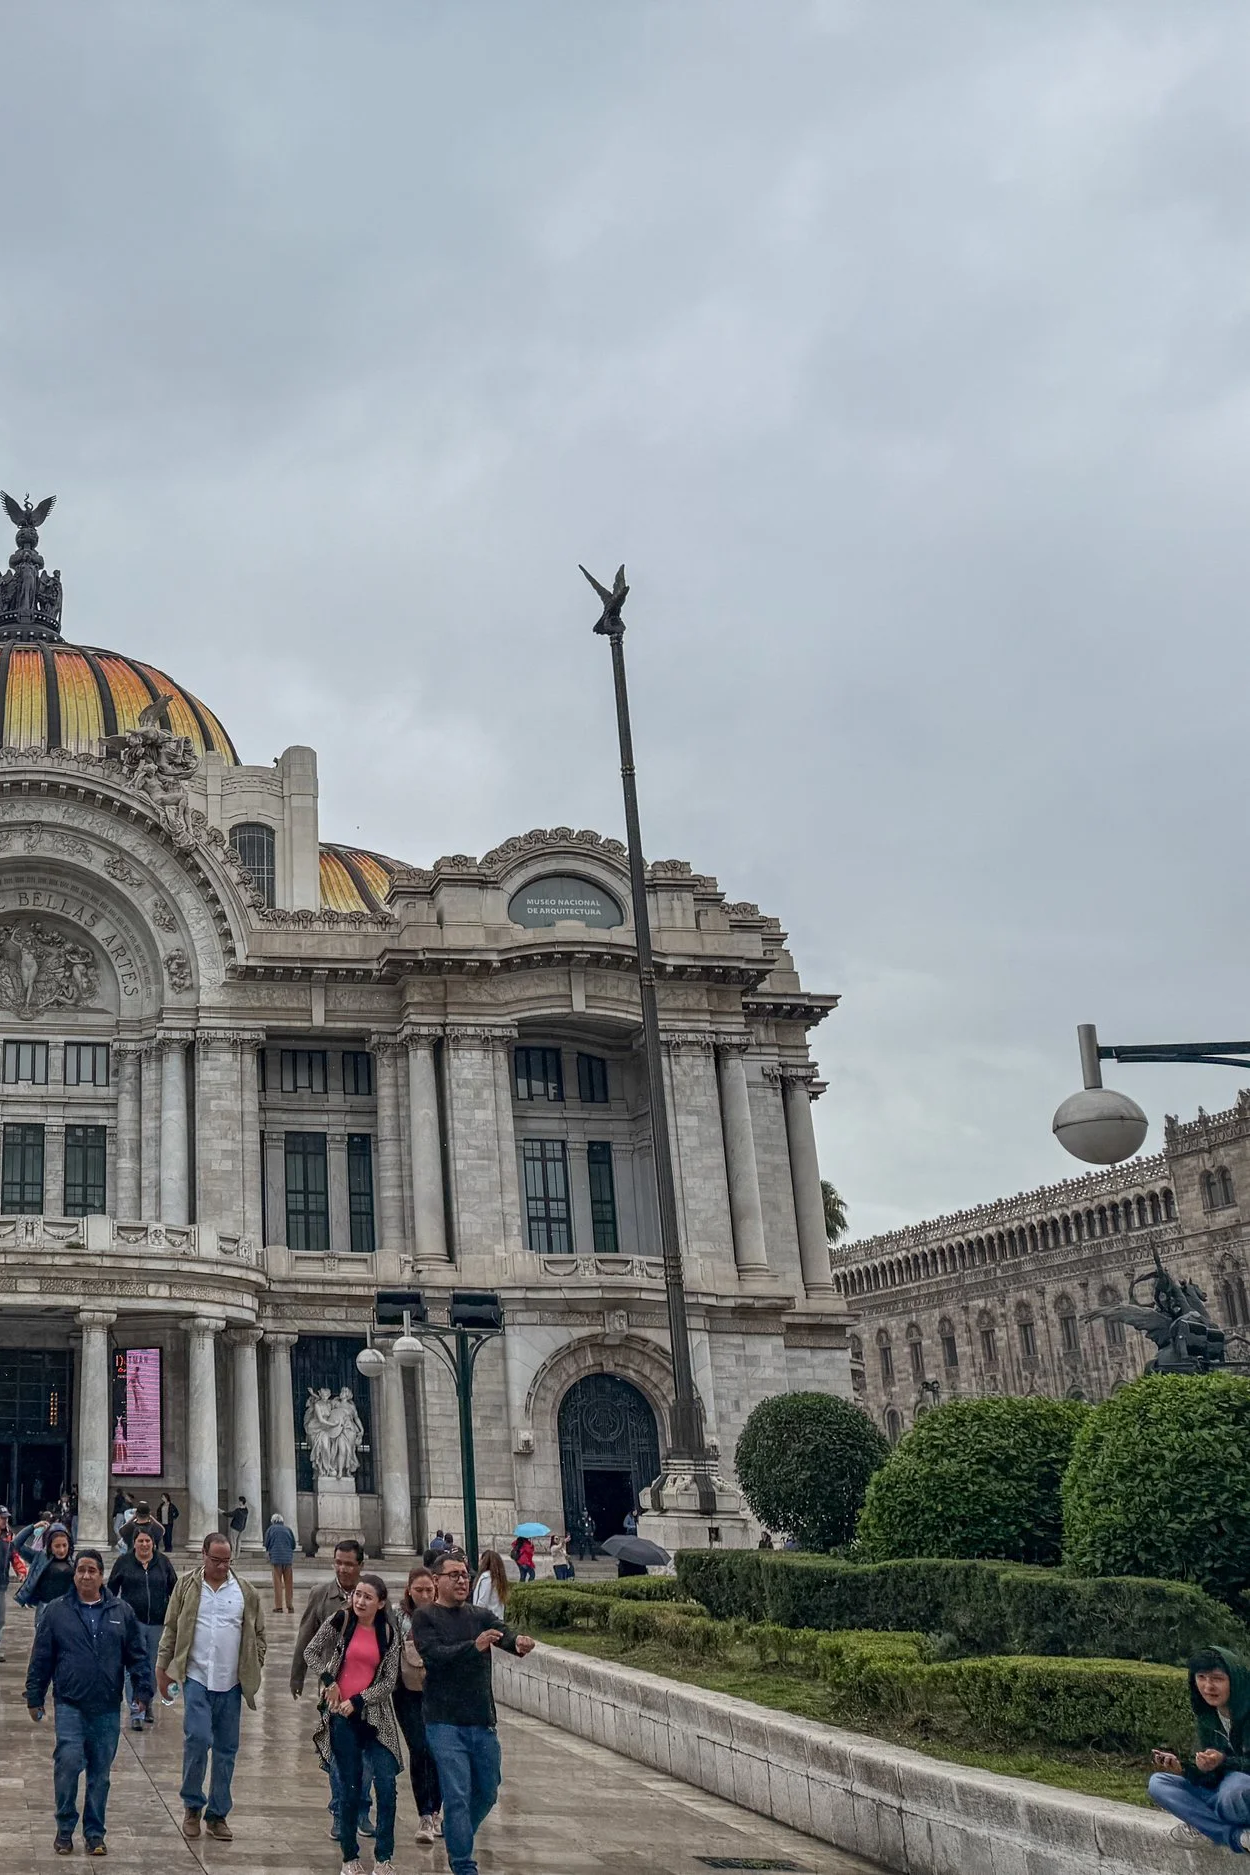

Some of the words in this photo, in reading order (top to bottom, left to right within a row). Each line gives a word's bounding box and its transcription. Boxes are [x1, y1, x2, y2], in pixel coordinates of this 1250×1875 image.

[526, 898, 556, 906] MUSEO
[557, 898, 601, 907] NACIONAL
[539, 907, 602, 916] ARQUITECTURA
[18, 891, 100, 929] BELLAS
[101, 934, 139, 997] ARTES
